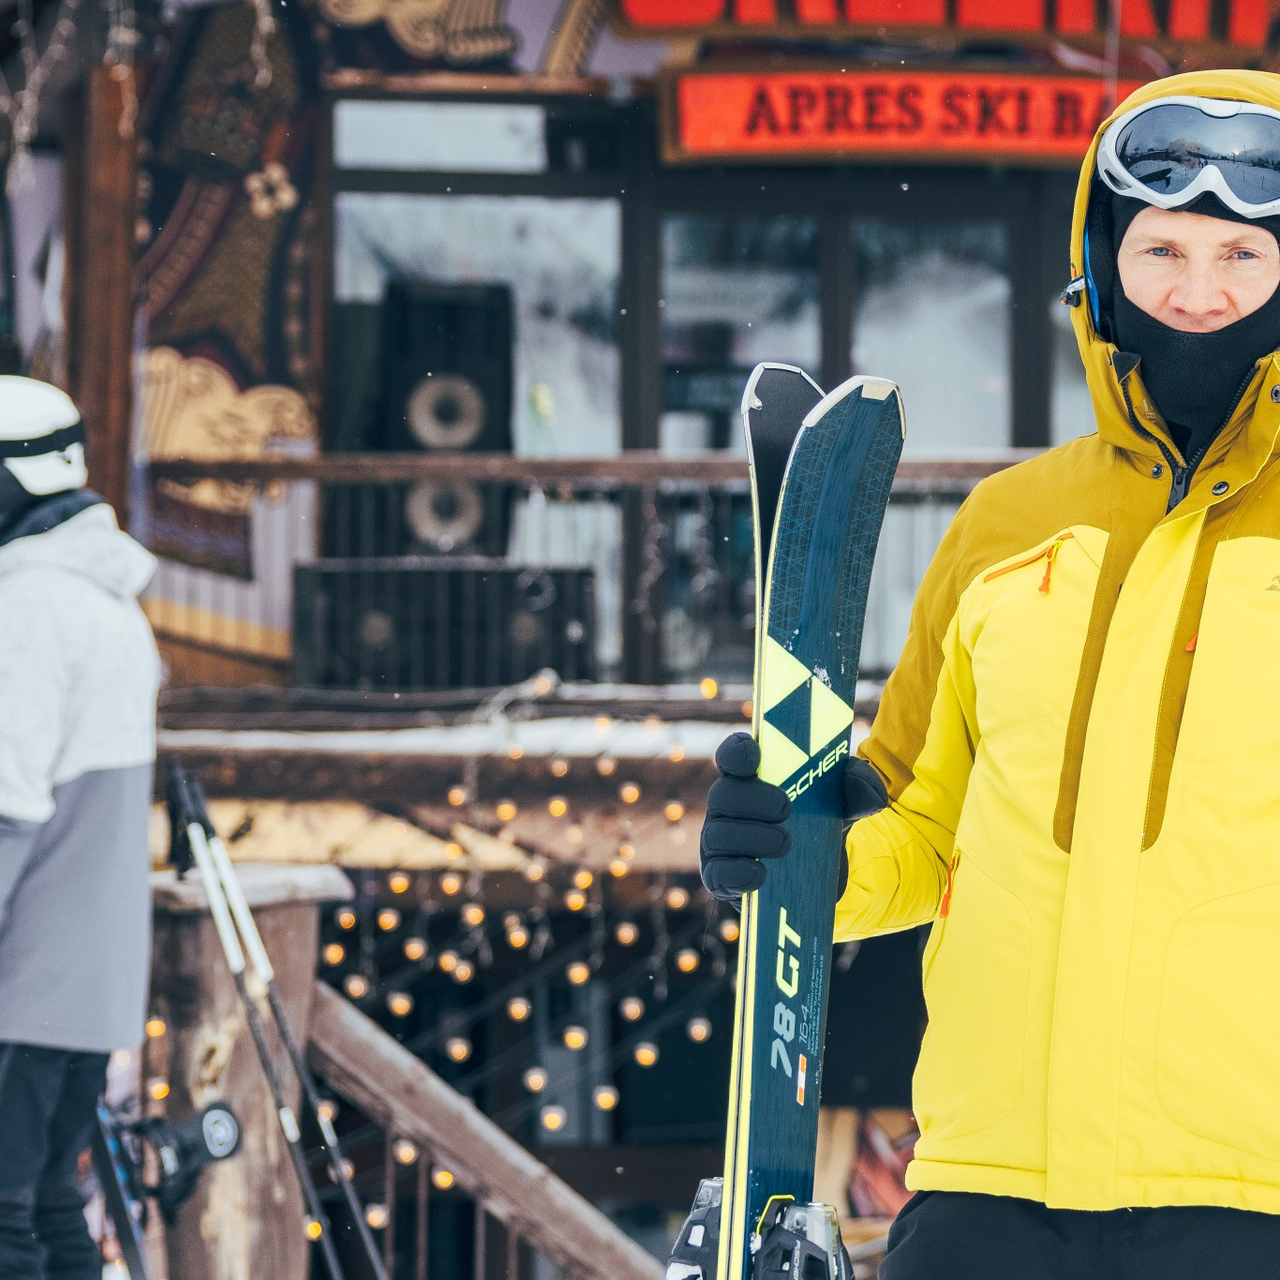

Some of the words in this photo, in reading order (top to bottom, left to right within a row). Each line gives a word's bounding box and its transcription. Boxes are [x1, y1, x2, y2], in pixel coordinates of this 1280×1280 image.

[745, 82, 926, 137] APRES
[939, 85, 1033, 137] SKI
[785, 739, 849, 802] SCHER
[775, 906, 802, 999] GT
[771, 1001, 796, 1079] 78
[798, 1003, 809, 1044] 164
